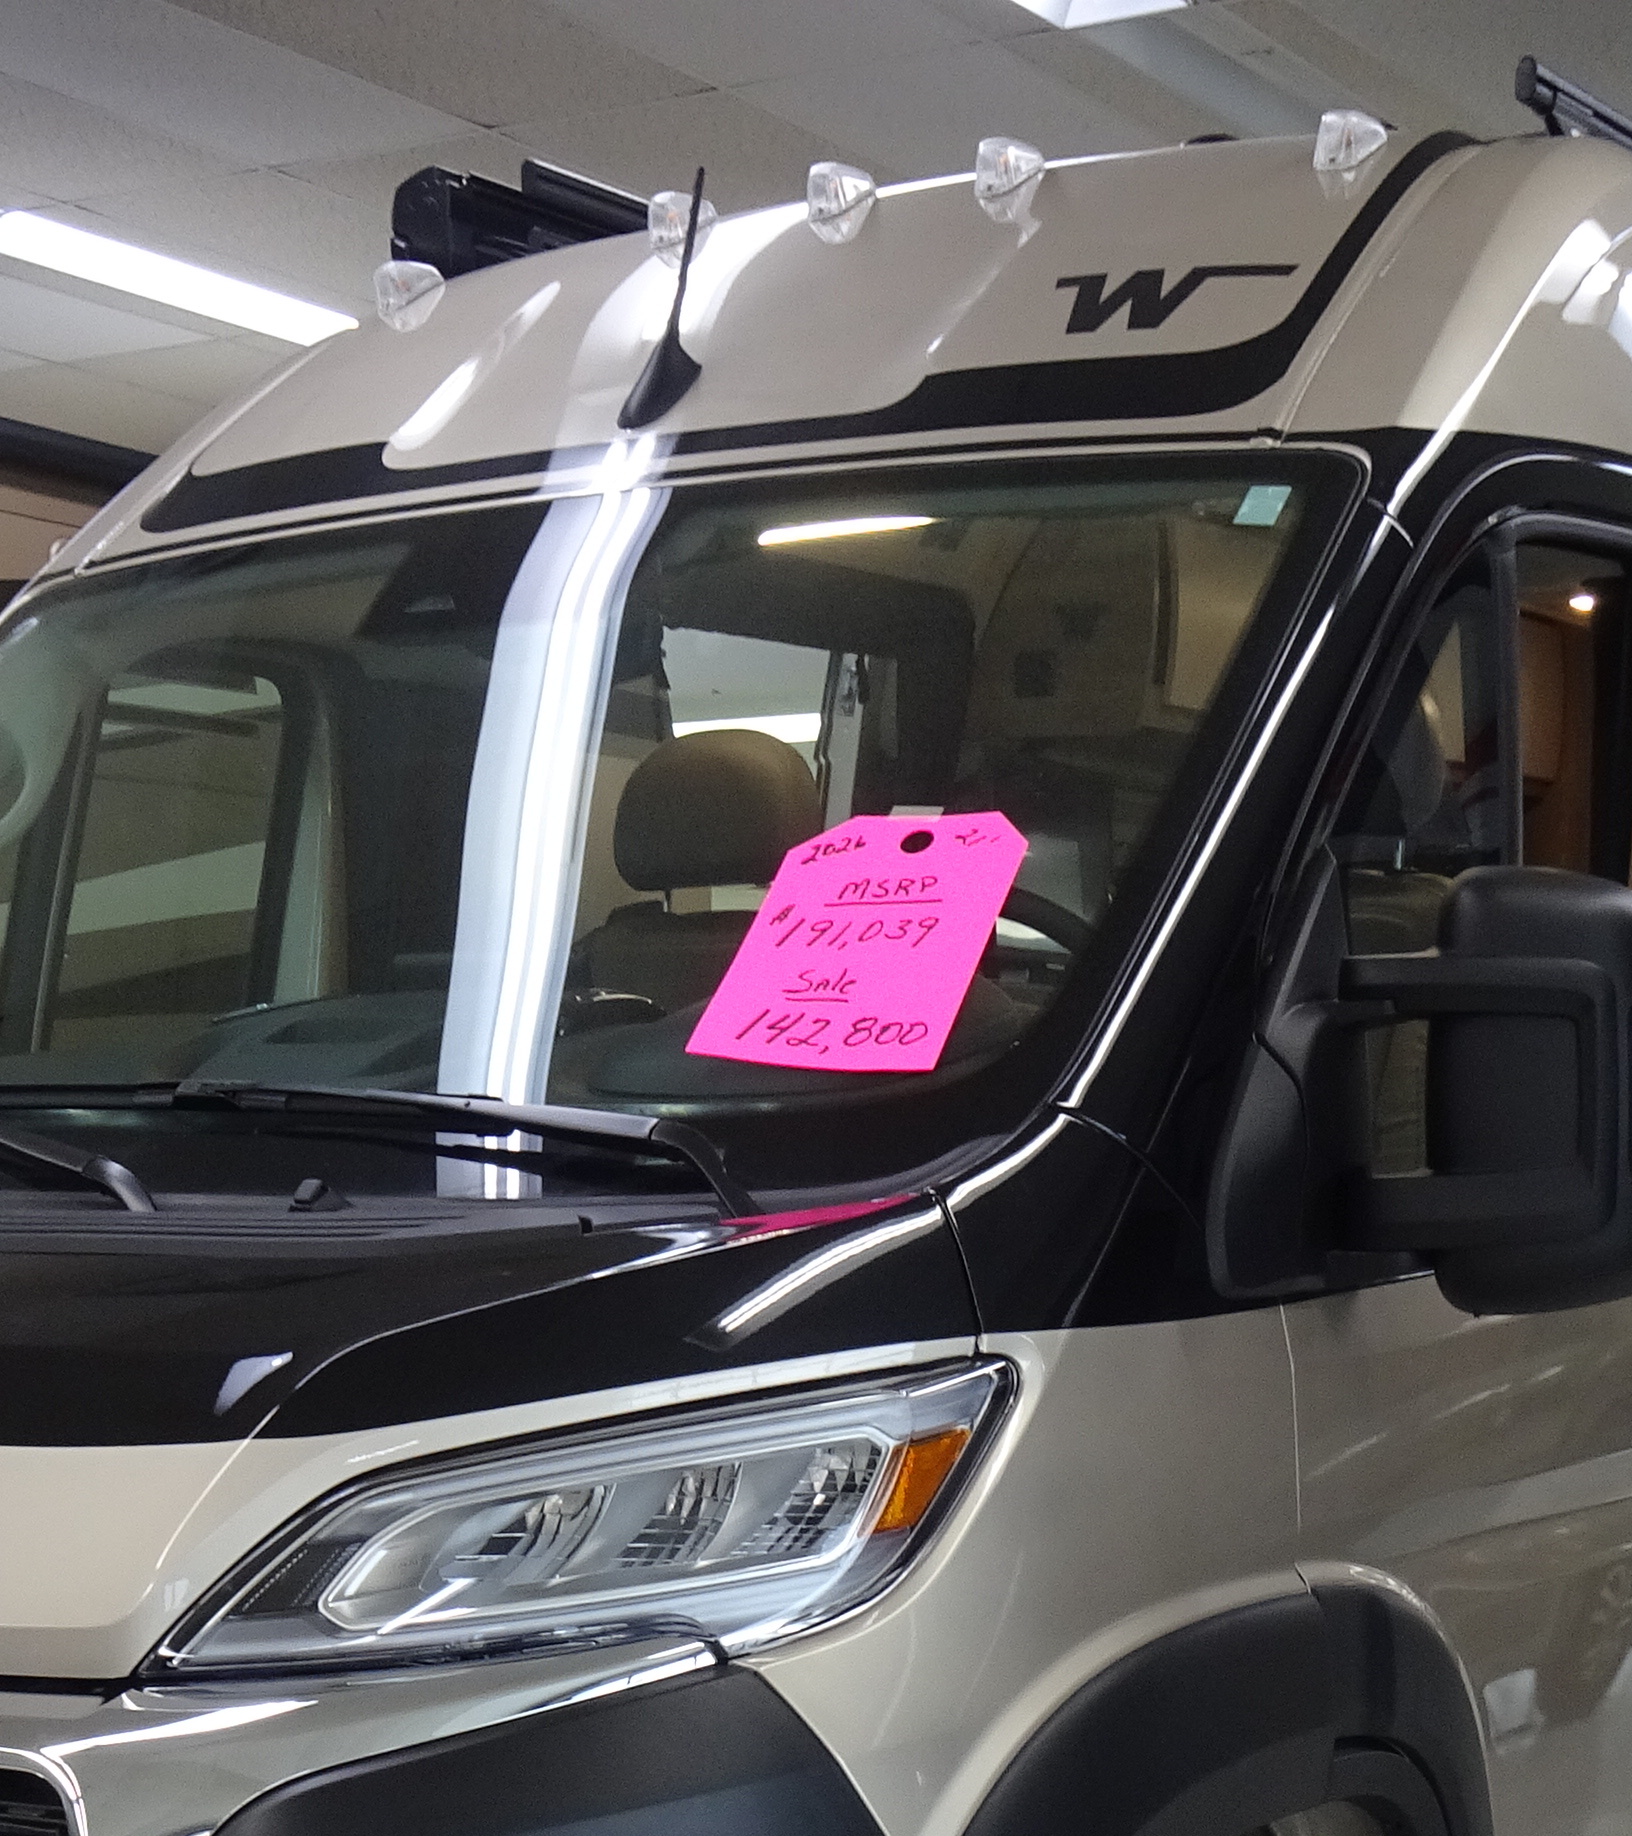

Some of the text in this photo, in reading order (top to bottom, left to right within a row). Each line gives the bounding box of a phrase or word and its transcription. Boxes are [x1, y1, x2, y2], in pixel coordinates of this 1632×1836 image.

[837, 876, 939, 901] MSRP
[782, 967, 857, 995] Sale
[736, 1009, 929, 1054] 142,800
